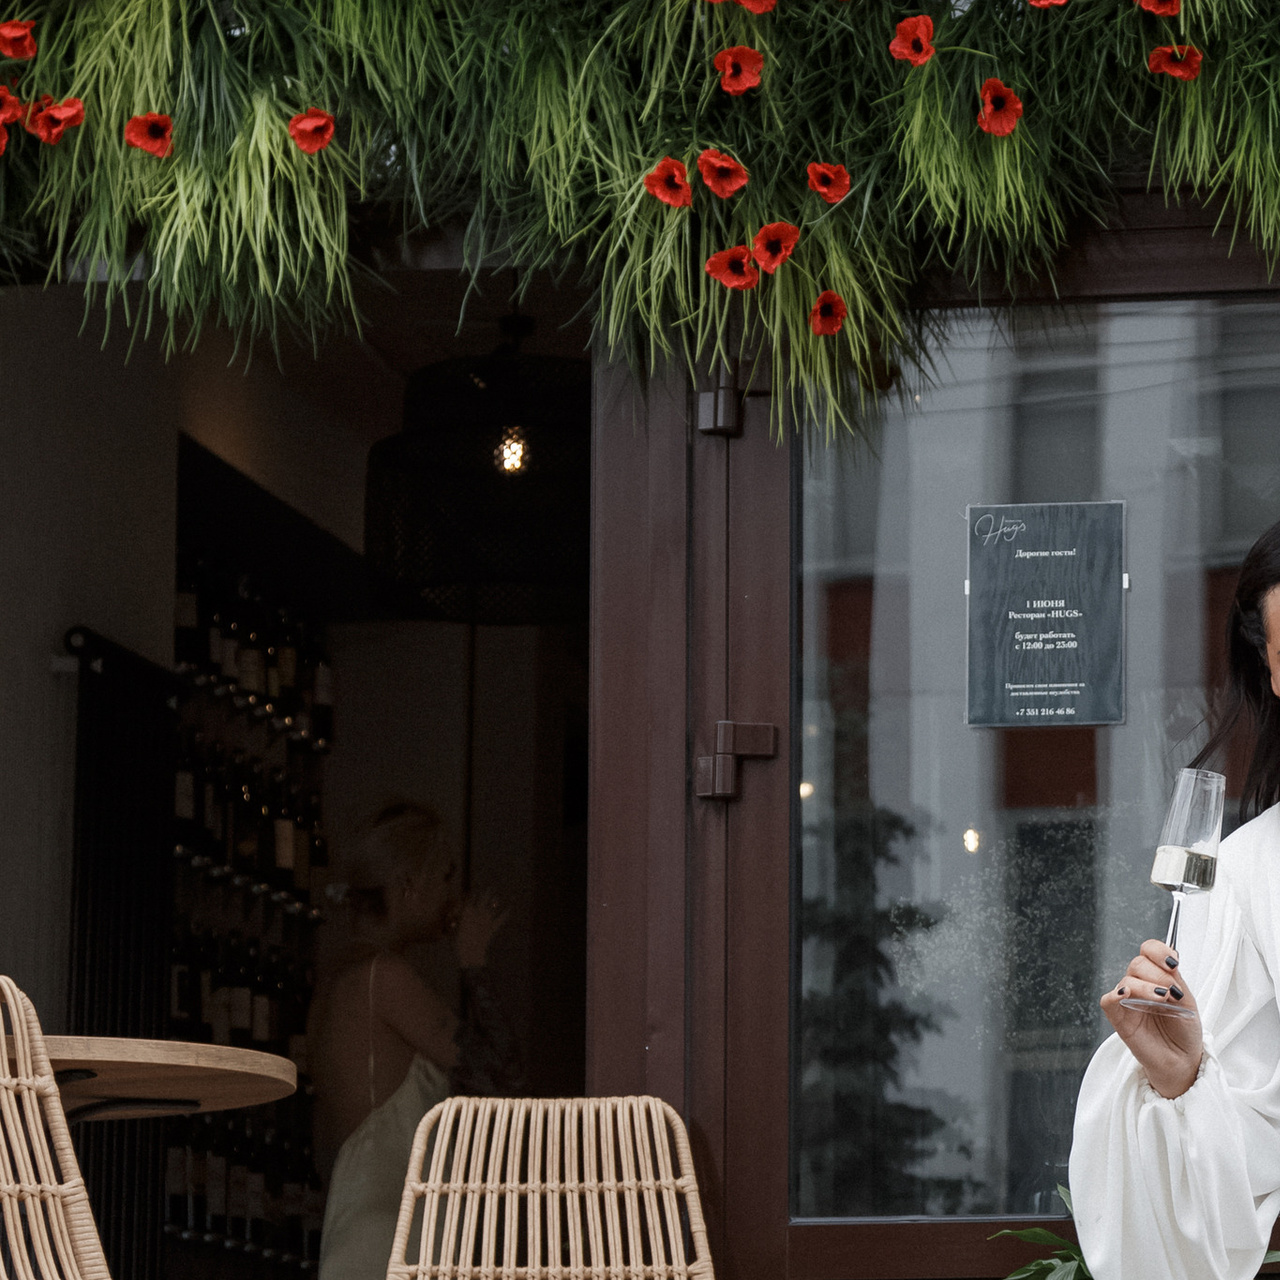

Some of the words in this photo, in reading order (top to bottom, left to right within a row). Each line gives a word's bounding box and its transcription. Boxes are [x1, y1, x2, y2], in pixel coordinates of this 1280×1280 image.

[974, 513, 1027, 546] Hugs
[1014, 549, 1049, 559] Дорогие
[1051, 548, 1077, 556] гости!
[1026, 600, 1030, 608] 1
[1032, 600, 1065, 608] ИЮНЯ
[1008, 611, 1045, 620] Ресторан
[1014, 631, 1038, 641] будет
[1039, 631, 1076, 640] работать
[1022, 641, 1043, 650] 12:00
[1040, 707, 1054, 716] 216
[1055, 707, 1065, 715] 46
[1065, 707, 1076, 715] 86
